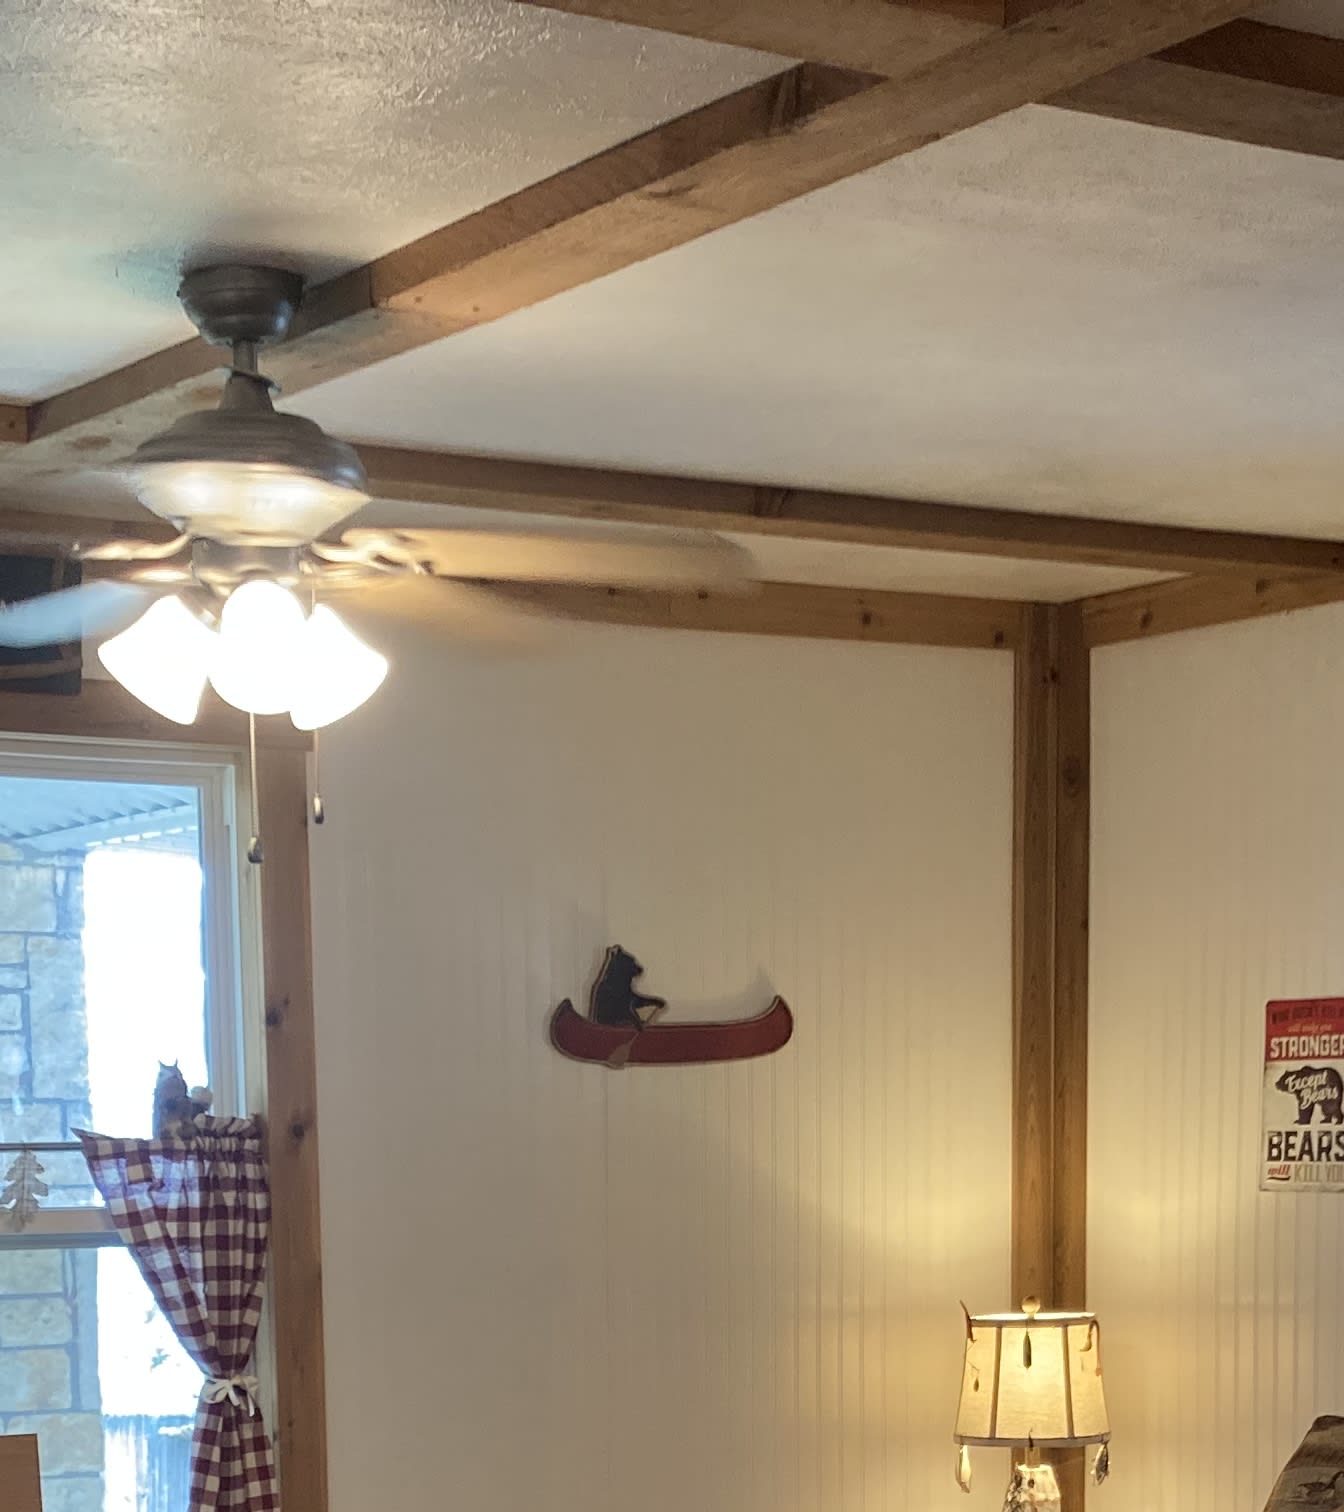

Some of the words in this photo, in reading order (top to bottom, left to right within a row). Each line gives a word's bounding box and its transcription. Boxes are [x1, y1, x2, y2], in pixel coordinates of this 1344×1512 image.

[1284, 1070, 1329, 1093] Except
[1300, 1087, 1339, 1111] Bears
[1293, 1163, 1322, 1183] KILL
